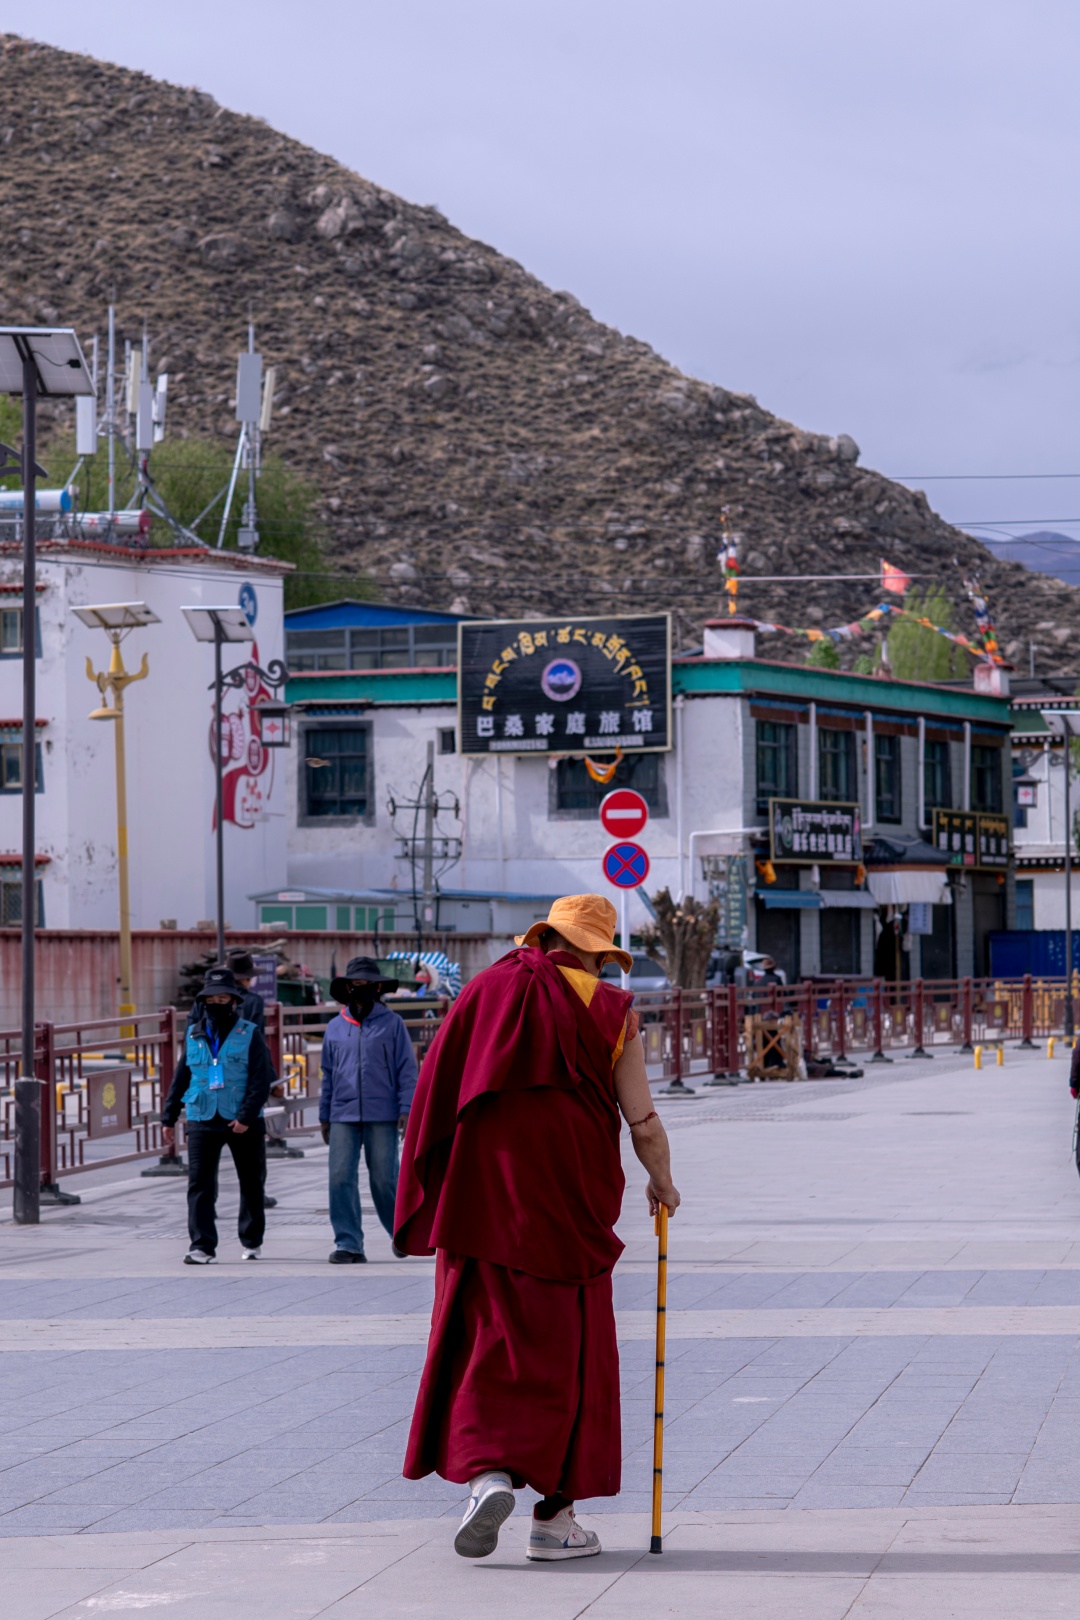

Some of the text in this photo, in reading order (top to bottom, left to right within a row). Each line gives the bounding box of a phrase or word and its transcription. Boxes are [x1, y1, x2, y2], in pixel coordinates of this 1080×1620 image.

[476, 709, 653, 737] 巴桑家庭旅馆
